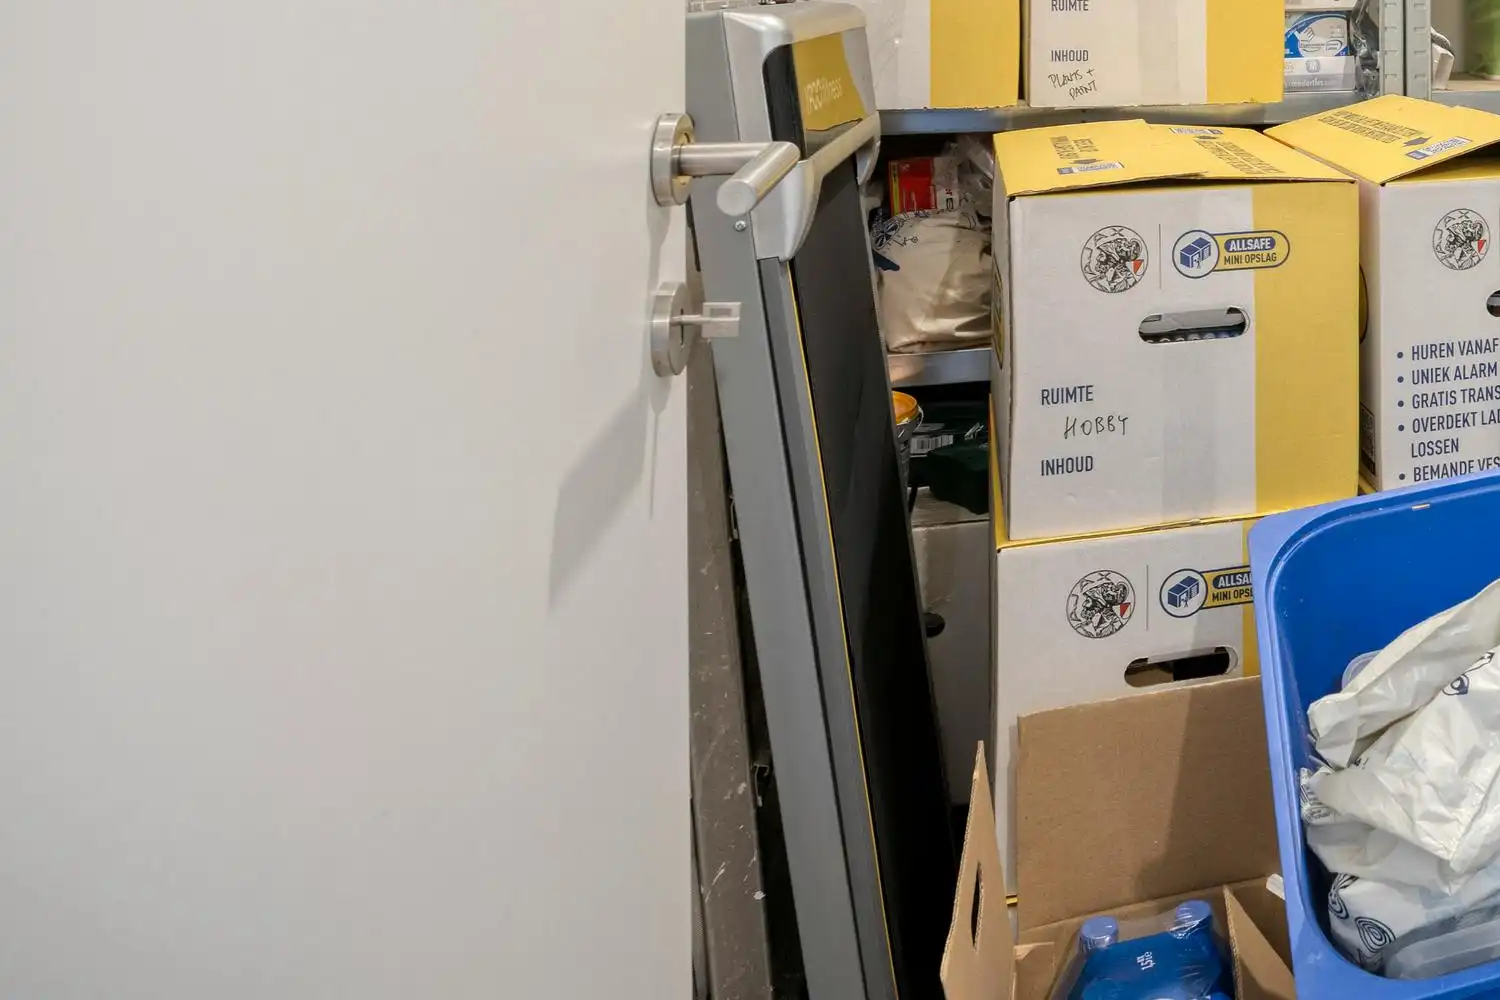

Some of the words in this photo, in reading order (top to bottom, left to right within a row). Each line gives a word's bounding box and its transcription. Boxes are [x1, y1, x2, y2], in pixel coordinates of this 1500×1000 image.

[1051, 0, 1089, 11] RUIMTE
[1051, 50, 1089, 62] INHOUD
[1229, 238, 1271, 251] ALLSAFE
[1224, 254, 1243, 265] MINI
[1245, 252, 1277, 264] OPSLAG
[1411, 342, 1455, 361] HUREN
[1458, 338, 1500, 357] VANAF
[1412, 365, 1451, 385] UNIEK
[1454, 362, 1498, 382] ALARM
[1041, 385, 1094, 406] RUIMTE
[1412, 390, 1457, 410] GRATIS
[1064, 415, 1128, 439] HOBBY
[1412, 411, 1477, 434] OVERDEKT
[1411, 438, 1460, 458] LOSSEN
[1041, 455, 1094, 476] INHOUD
[1413, 459, 1475, 482] BEMANDE
[1212, 592, 1231, 602] MINI
